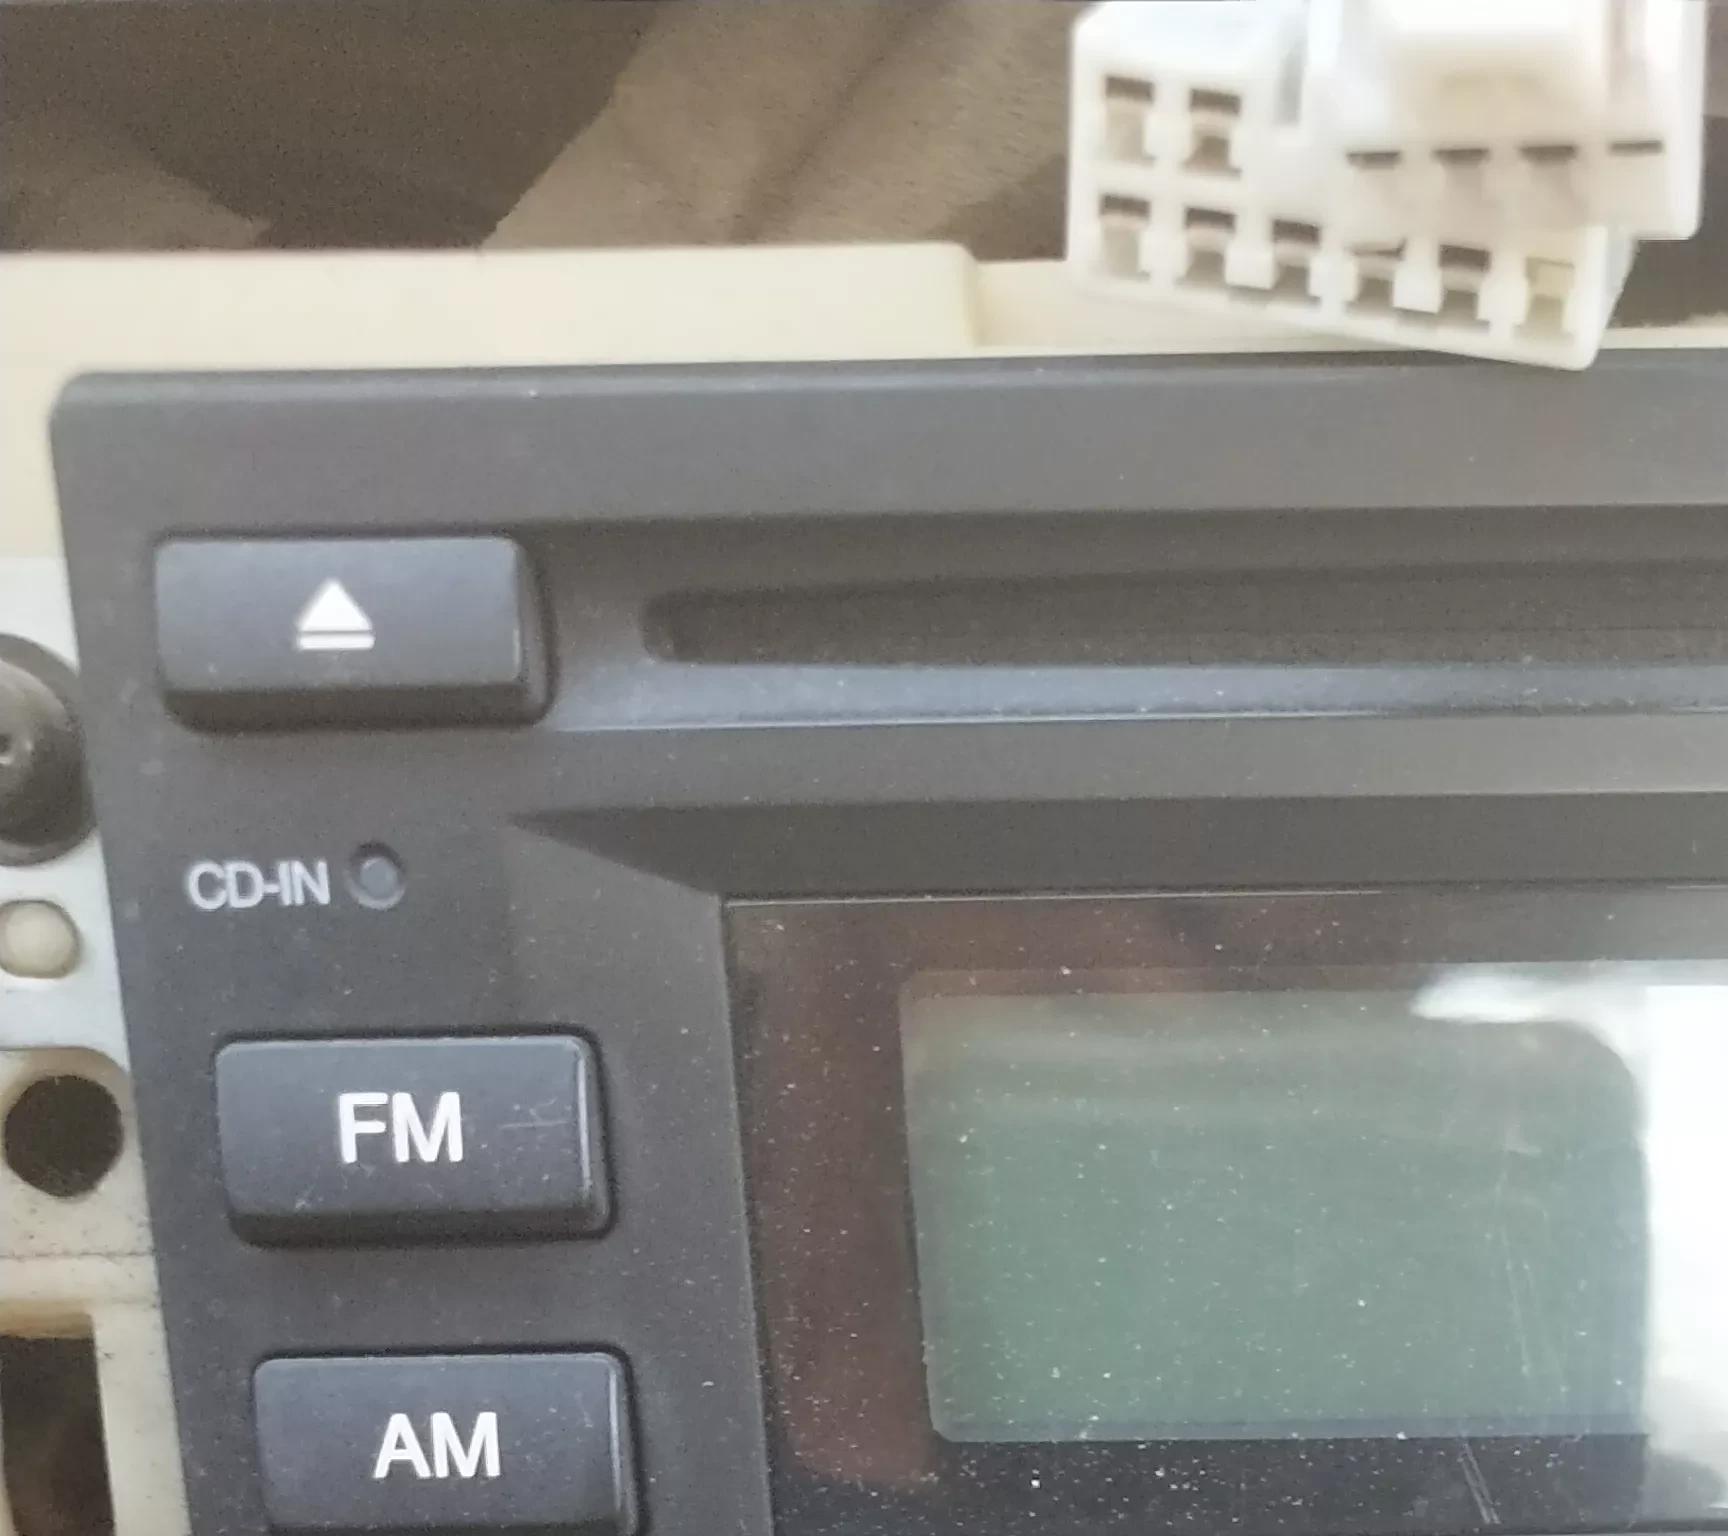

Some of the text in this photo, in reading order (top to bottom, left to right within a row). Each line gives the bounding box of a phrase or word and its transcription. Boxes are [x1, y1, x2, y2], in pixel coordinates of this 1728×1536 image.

[187, 860, 331, 910] CD-IN
[338, 1091, 463, 1164] FM
[374, 1411, 500, 1479] AM
